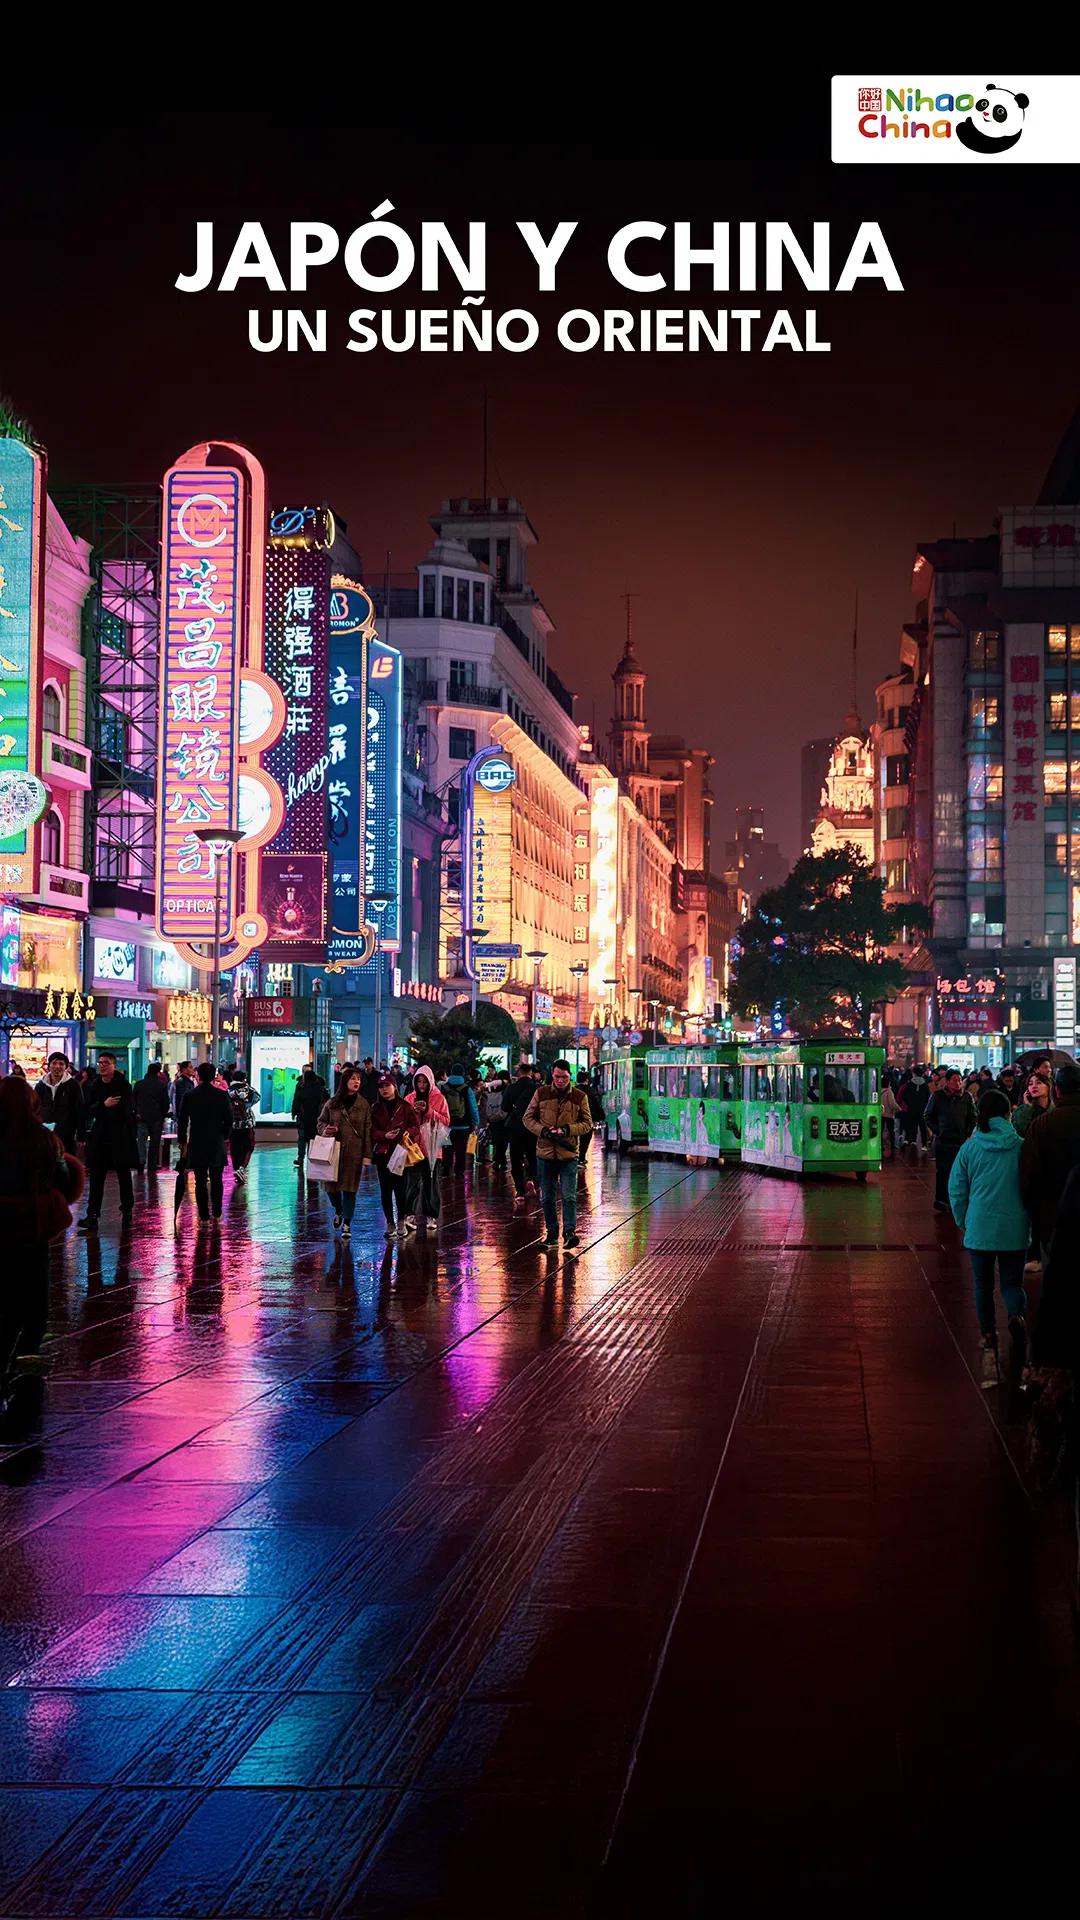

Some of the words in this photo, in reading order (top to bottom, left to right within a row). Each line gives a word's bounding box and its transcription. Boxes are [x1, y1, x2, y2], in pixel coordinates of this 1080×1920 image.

[385, 858, 398, 929] Pharacy
[166, 898, 223, 912] OPTICA
[253, 1001, 272, 1010] BUS
[829, 1121, 860, 1136] 豆本豆
